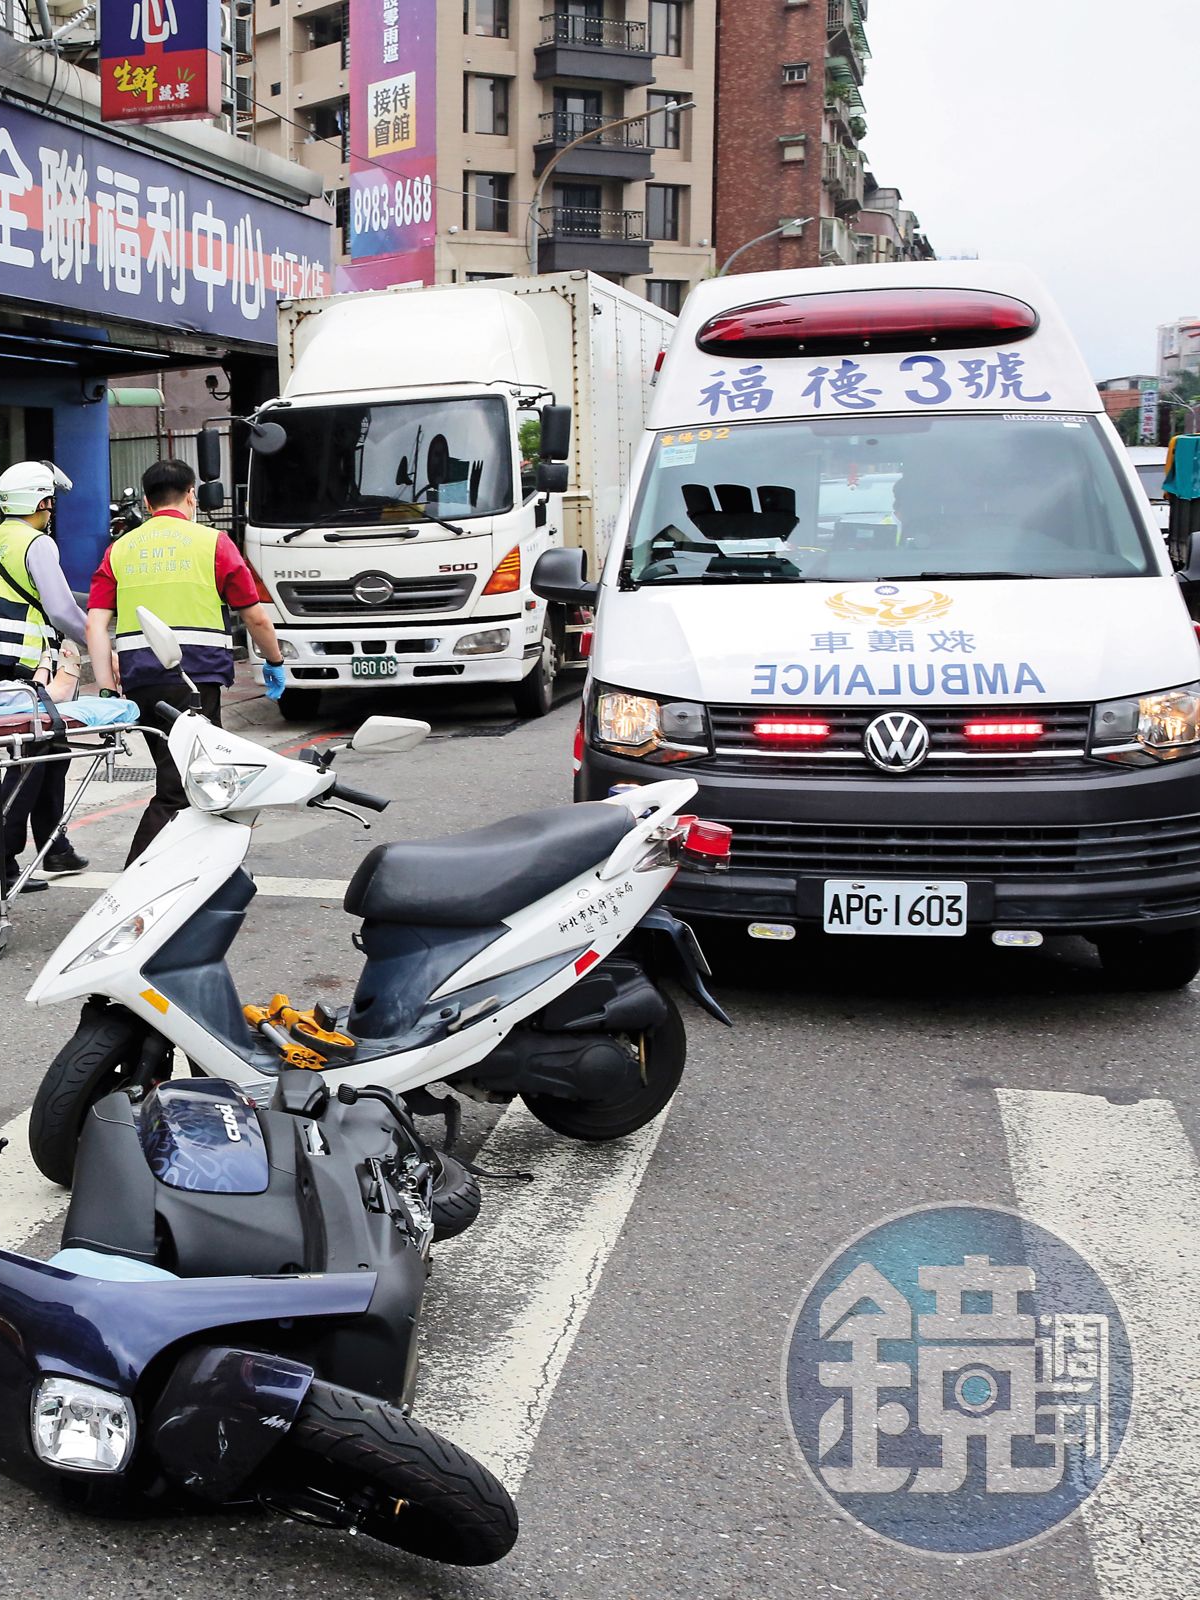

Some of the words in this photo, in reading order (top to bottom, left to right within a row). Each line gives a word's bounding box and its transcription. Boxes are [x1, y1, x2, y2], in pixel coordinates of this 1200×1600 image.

[130, 0, 178, 43] 心
[354, 174, 432, 235] 8983-8688
[698, 352, 1052, 416] 福德3號
[140, 546, 177, 559] EMT
[273, 569, 321, 580] HINO
[438, 562, 478, 573] 500
